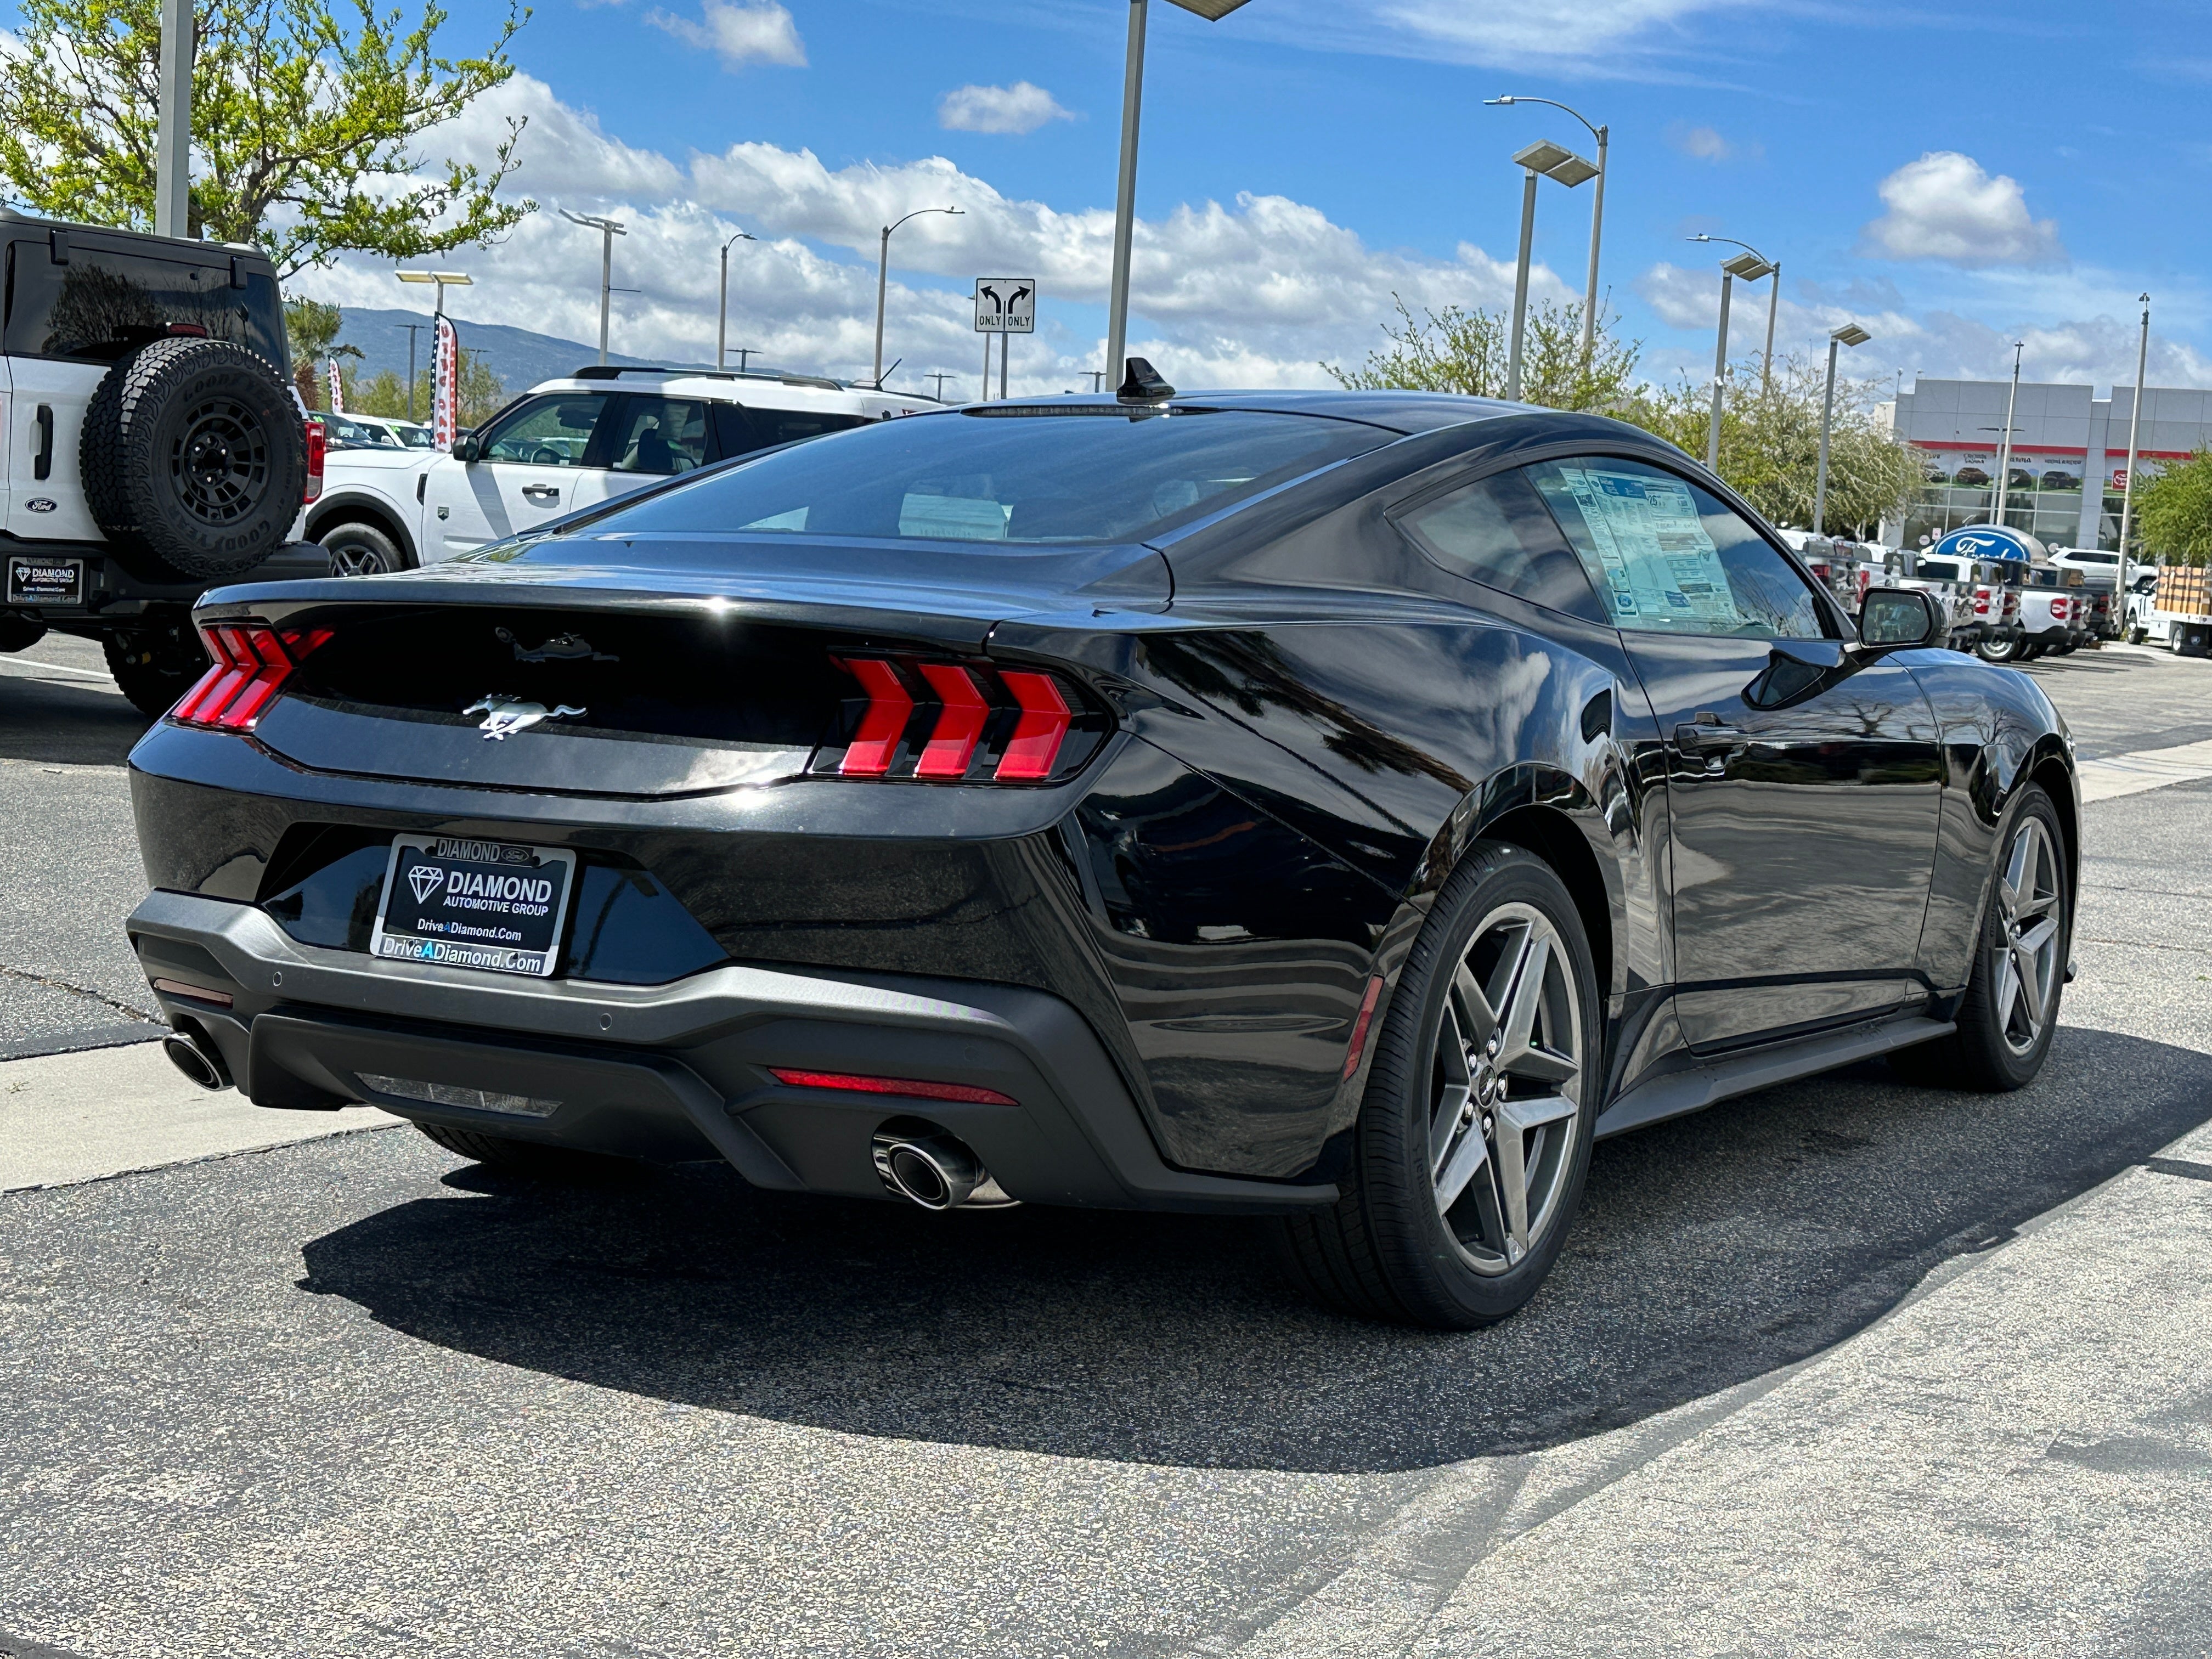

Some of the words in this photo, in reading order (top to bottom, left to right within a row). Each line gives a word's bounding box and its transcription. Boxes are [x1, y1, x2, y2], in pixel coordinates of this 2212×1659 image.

[979, 316, 1001, 325] ONLY
[1008, 317, 1030, 326] ONLY
[32, 568, 75, 578] DIAMOND
[437, 839, 501, 862] DIAMOND
[447, 871, 552, 902] DIAMOND
[443, 895, 509, 913] AUTOMOTIVE
[512, 903, 549, 916] GROUP
[417, 918, 522, 941] DriveADiamond.Com
[383, 938, 540, 972] DriveADiamond.Com
